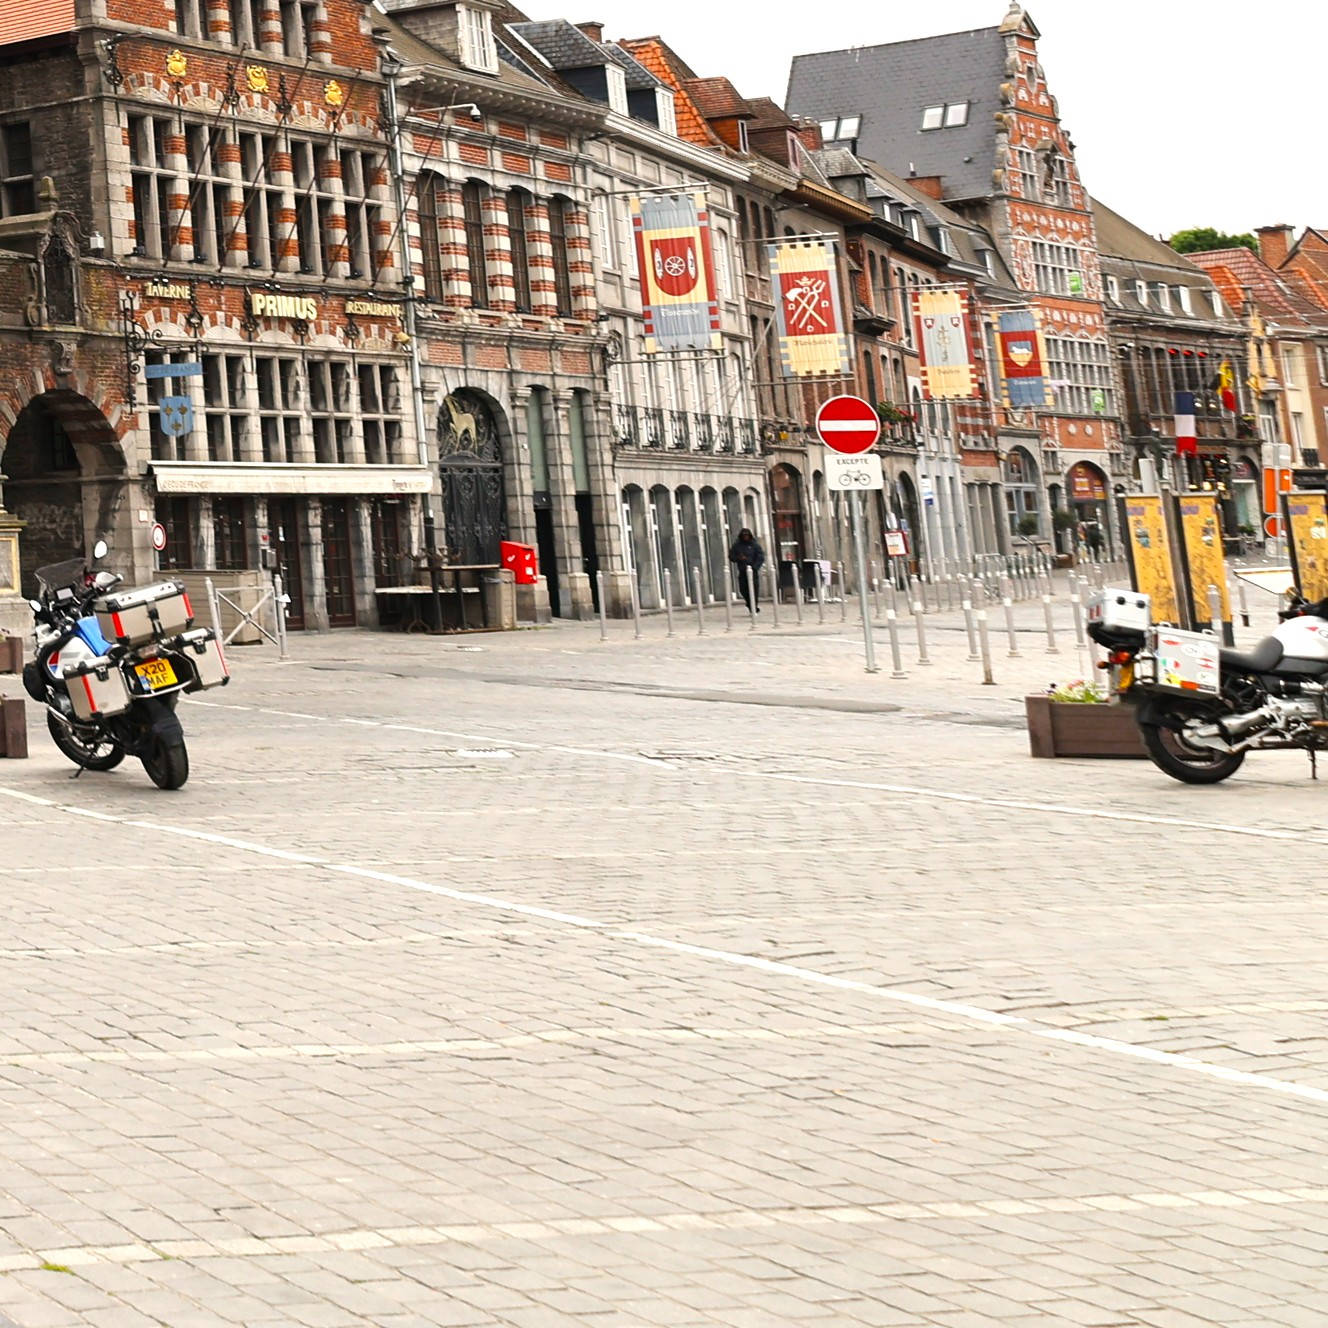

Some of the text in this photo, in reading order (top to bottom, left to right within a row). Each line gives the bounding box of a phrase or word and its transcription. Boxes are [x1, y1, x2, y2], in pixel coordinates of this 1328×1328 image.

[146, 282, 192, 299] TAVERNE
[252, 293, 318, 320] PRIMUS
[345, 301, 403, 317] RESTAURANT
[141, 663, 165, 676] X20
[146, 673, 169, 687] MAF
